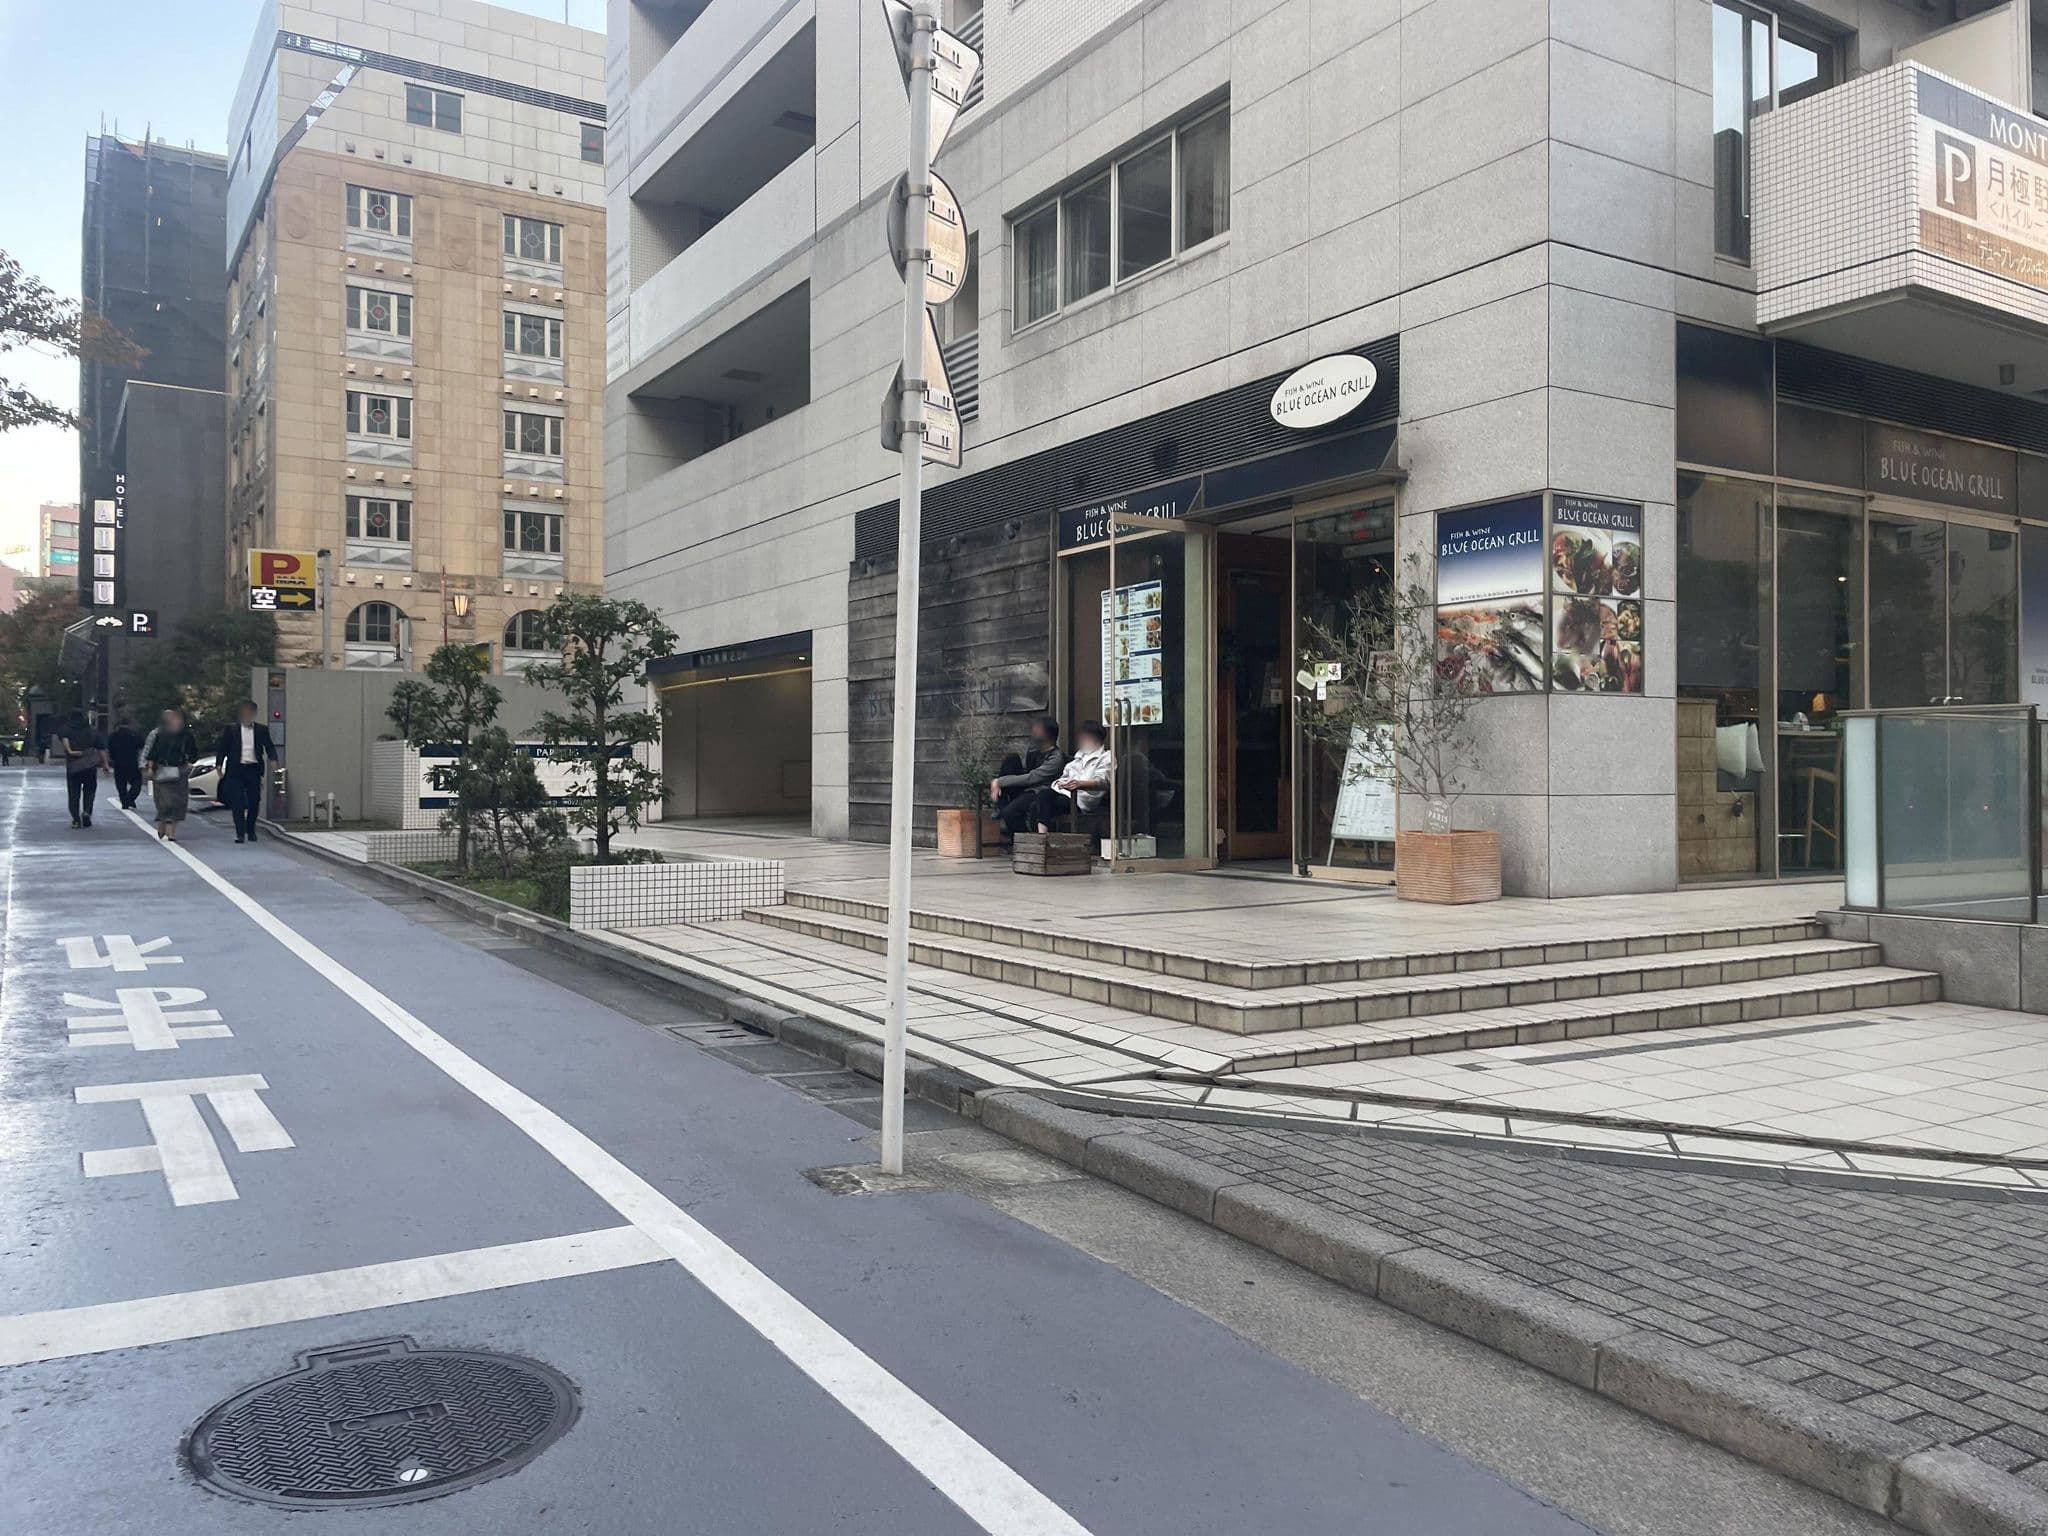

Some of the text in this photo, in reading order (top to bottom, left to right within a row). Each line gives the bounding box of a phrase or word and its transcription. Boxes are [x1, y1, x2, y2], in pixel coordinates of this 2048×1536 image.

[1943, 142, 1972, 206] P
[1276, 375, 1371, 416] BLUE OCEAN GRILL
[1285, 377, 1325, 397] FISH & WINE
[1880, 456, 2004, 500] BLUE OCEAN GRILL
[116, 474, 125, 529] HOTEL
[1085, 500, 1128, 519] FISH & WINE
[1583, 501, 1599, 510] WINE
[1558, 508, 1635, 528] BLUE OCEAN GRILL
[1076, 520, 1104, 542] BLUE
[1442, 529, 1540, 556] BLUE OCEAN GRILL
[1450, 532, 1463, 540] FISH
[1472, 526, 1491, 536] WINE
[97, 503, 112, 603] AILU
[261, 552, 300, 586] P
[251, 586, 277, 610] 空
[133, 613, 148, 632] P
